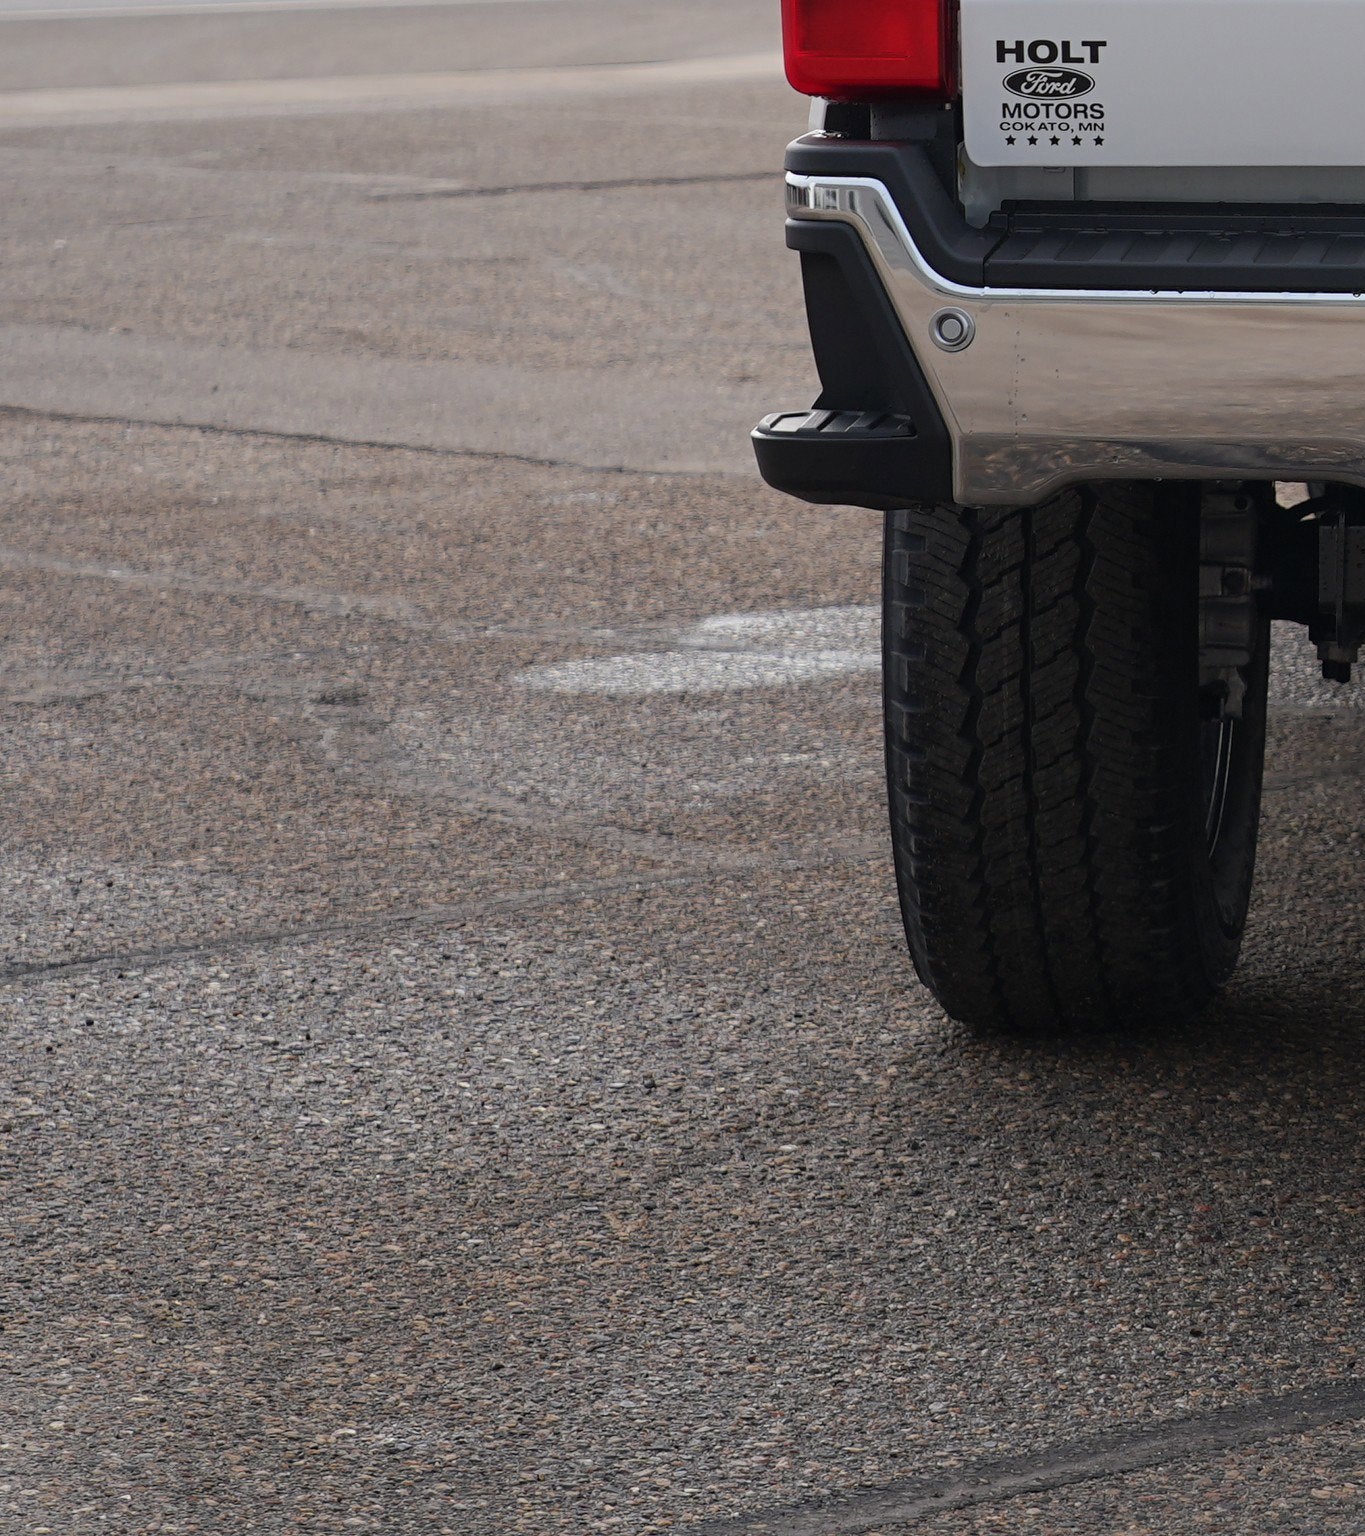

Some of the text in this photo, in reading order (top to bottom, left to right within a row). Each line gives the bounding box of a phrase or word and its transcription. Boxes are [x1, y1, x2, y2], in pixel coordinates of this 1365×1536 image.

[995, 39, 1107, 64] HOLT
[1020, 70, 1078, 95] Ford
[1001, 102, 1105, 119] MOTORS
[999, 121, 1105, 134] COKATO, MN
